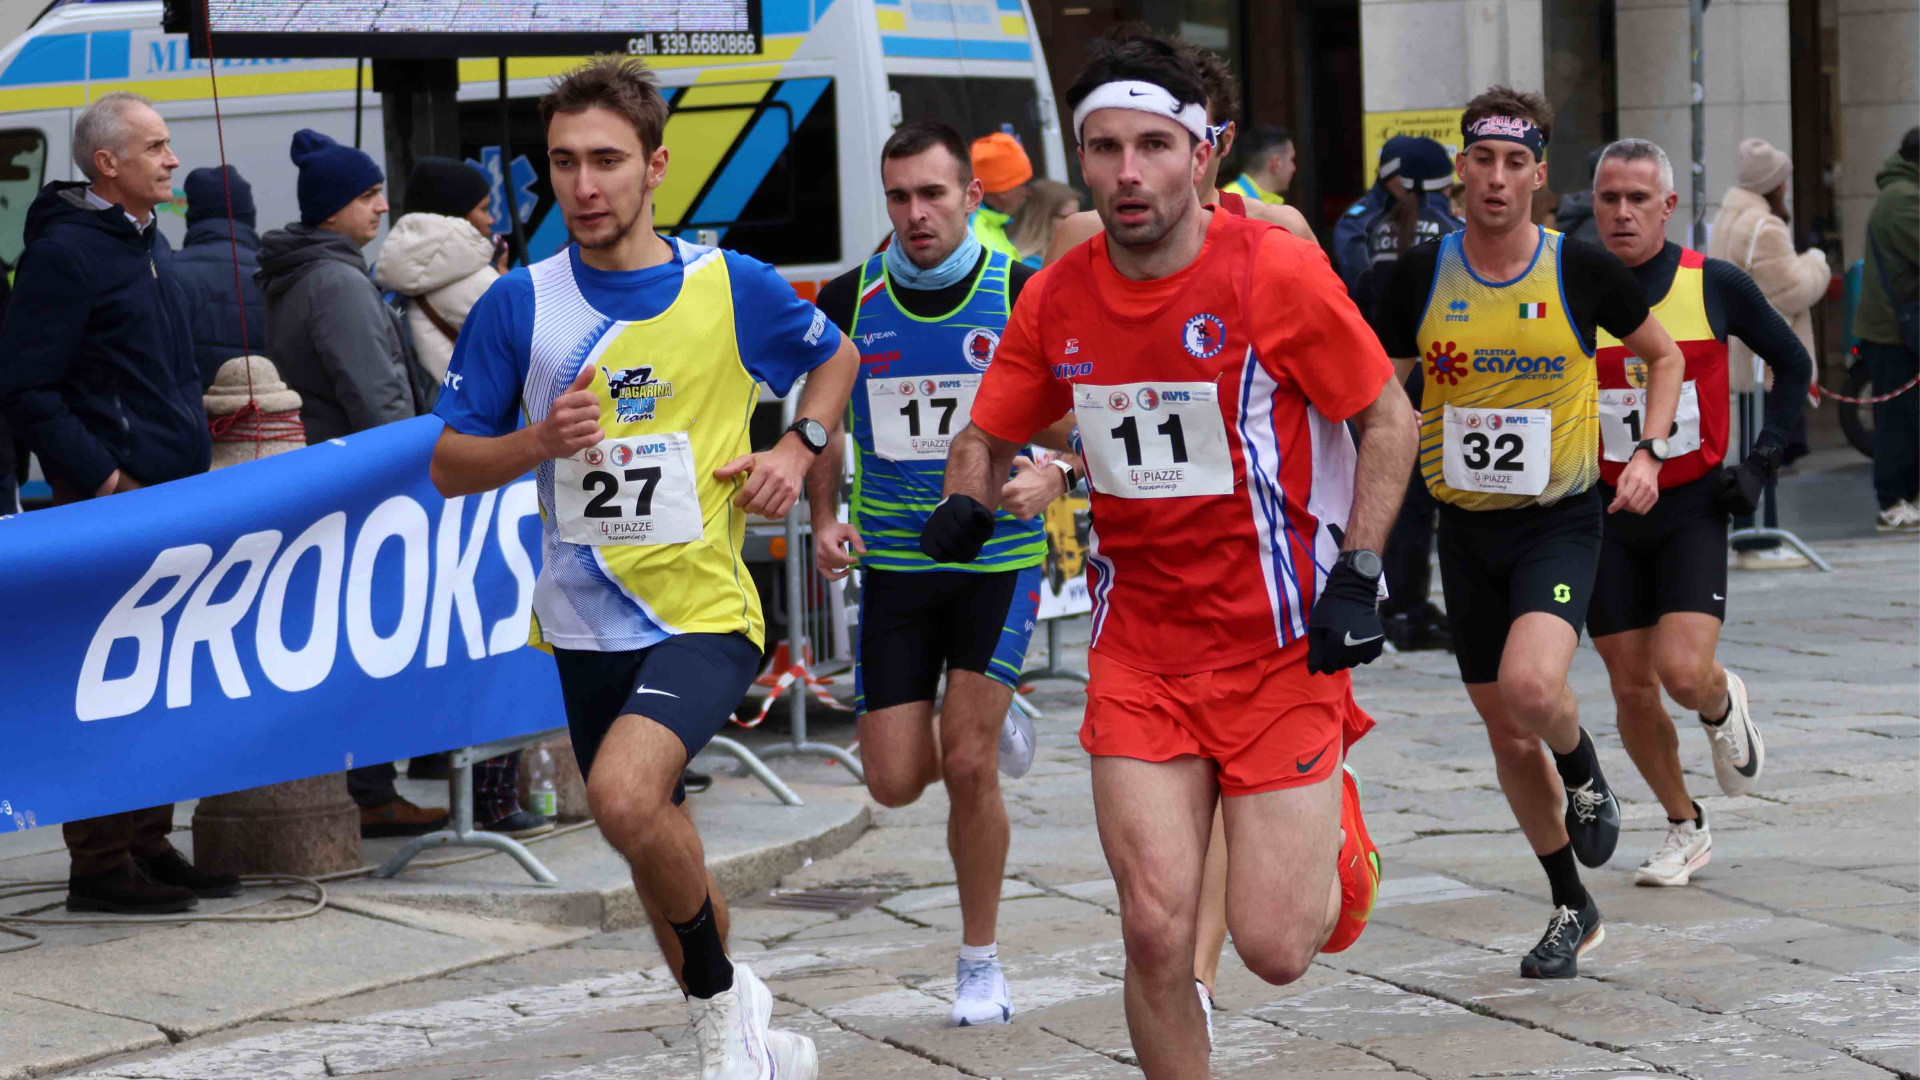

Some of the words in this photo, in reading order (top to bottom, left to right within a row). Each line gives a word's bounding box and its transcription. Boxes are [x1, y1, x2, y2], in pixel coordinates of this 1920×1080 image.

[628, 33, 657, 54] cell.
[661, 33, 756, 54] 339.6680866
[1186, 313, 1223, 328] ATLETICA
[1184, 345, 1222, 358] PIACENZA
[939, 380, 961, 388] AVIS
[619, 383, 672, 398] LAGARINA
[1162, 391, 1190, 401] AVIS
[900, 398, 958, 436] 17
[1505, 416, 1528, 424] AVIS
[1111, 413, 1188, 466] 11
[636, 443, 666, 454] AVIS
[1463, 432, 1524, 471] 32
[1144, 470, 1183, 482] PIAZZE
[1484, 475, 1512, 483] PIAZZE
[582, 466, 662, 518] 27
[1138, 483, 1177, 491] running
[614, 522, 652, 533] PIAZZE
[608, 534, 646, 542] running
[76, 480, 539, 722] BROOKS
